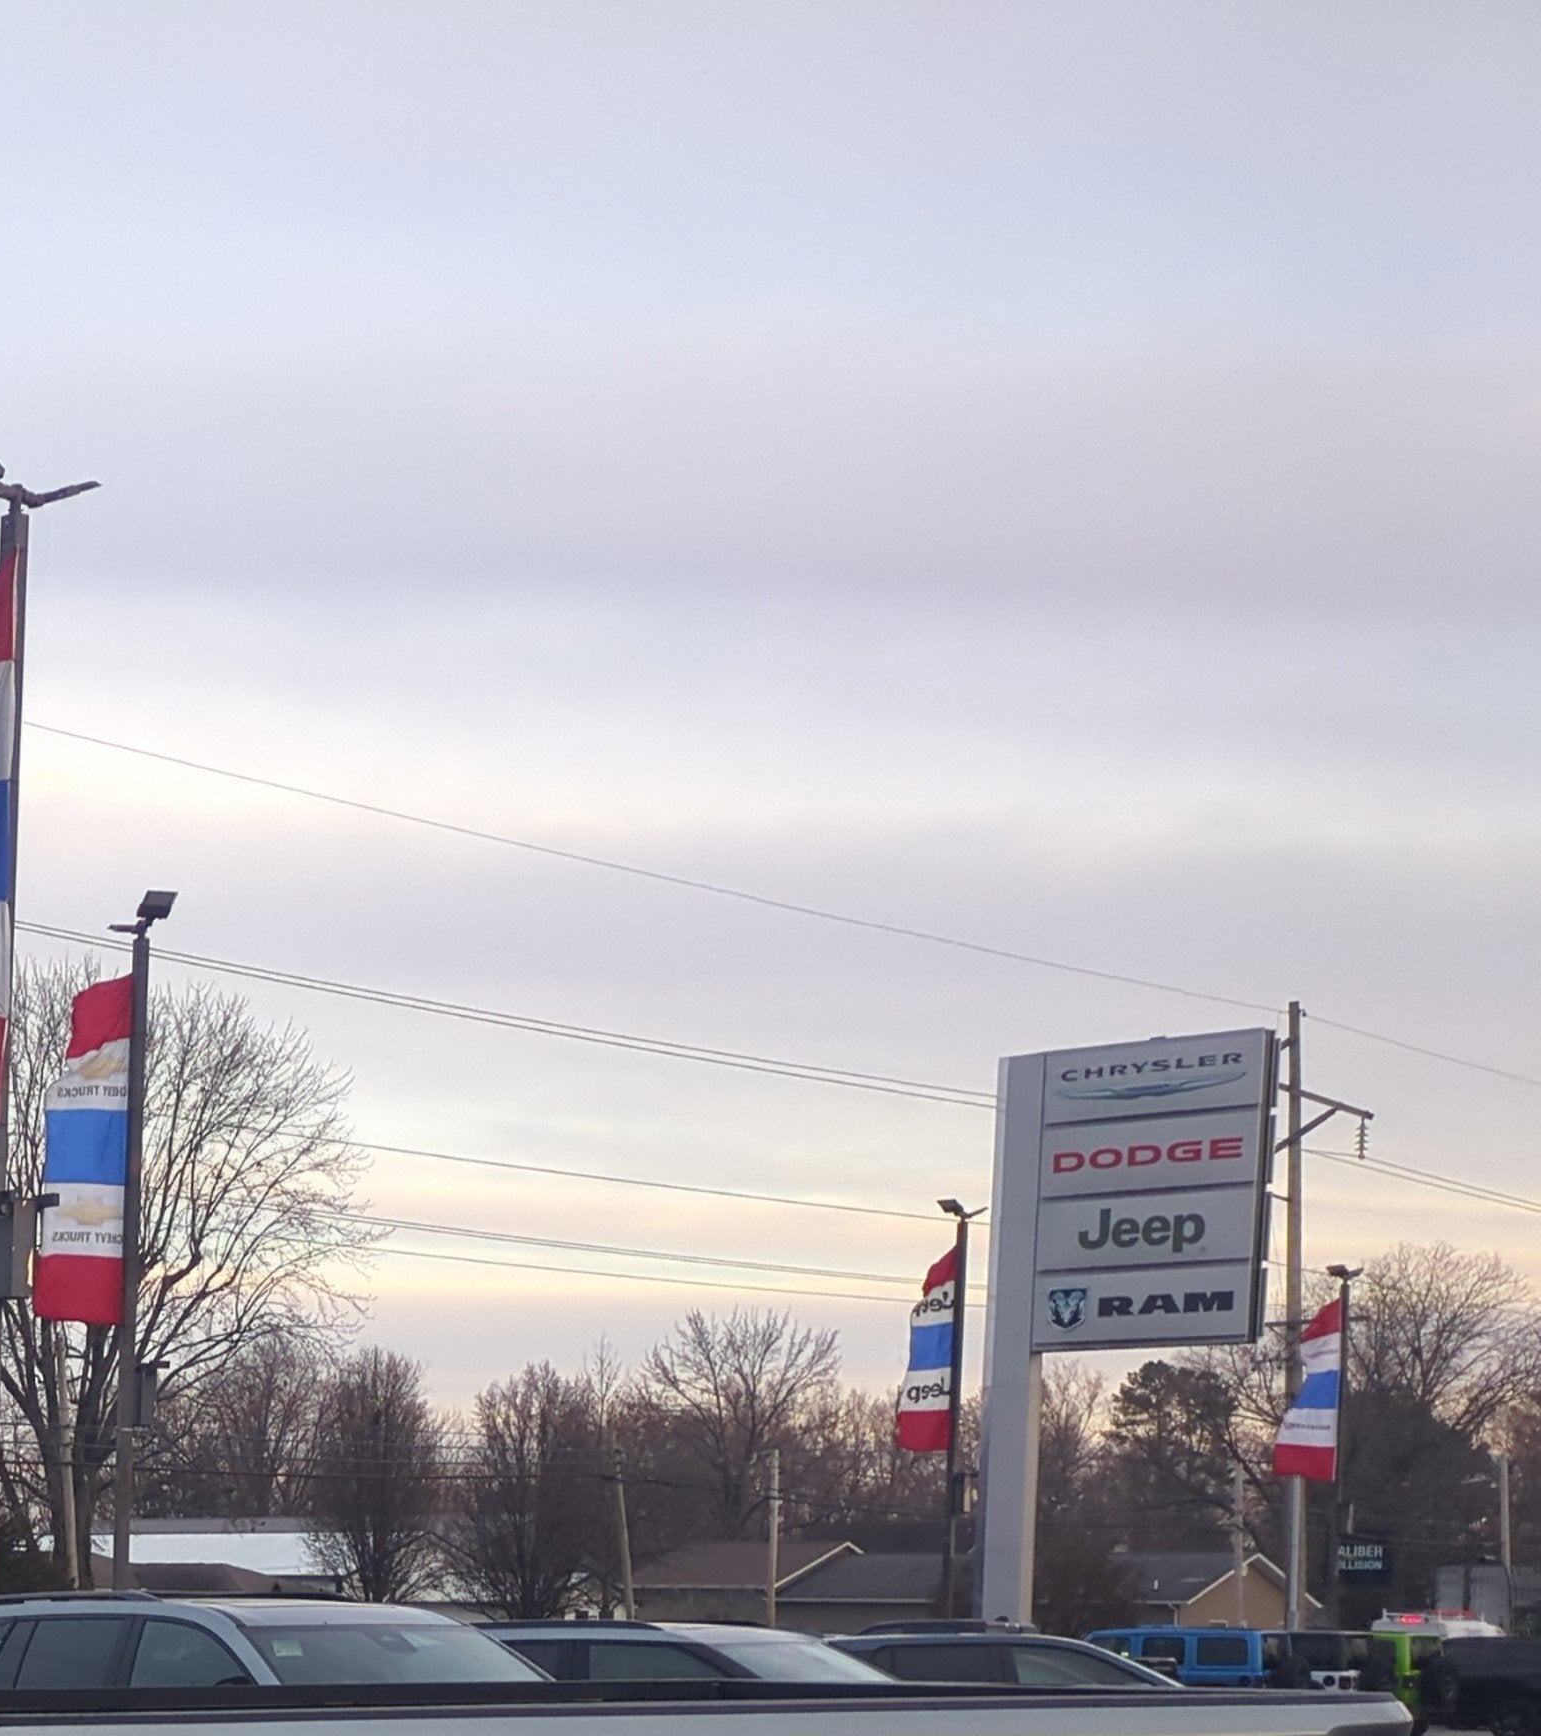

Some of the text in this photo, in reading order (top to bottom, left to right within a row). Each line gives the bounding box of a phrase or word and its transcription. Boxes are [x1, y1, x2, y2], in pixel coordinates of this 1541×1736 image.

[1060, 1052, 1244, 1083] CHRYSLER
[1052, 1136, 1244, 1174] DODGE
[1077, 1207, 1206, 1253] Jeep
[1097, 1290, 1235, 1318] RAM
[1337, 1545, 1383, 1557] ALIBER
[1337, 1560, 1383, 1570] OLLISION
